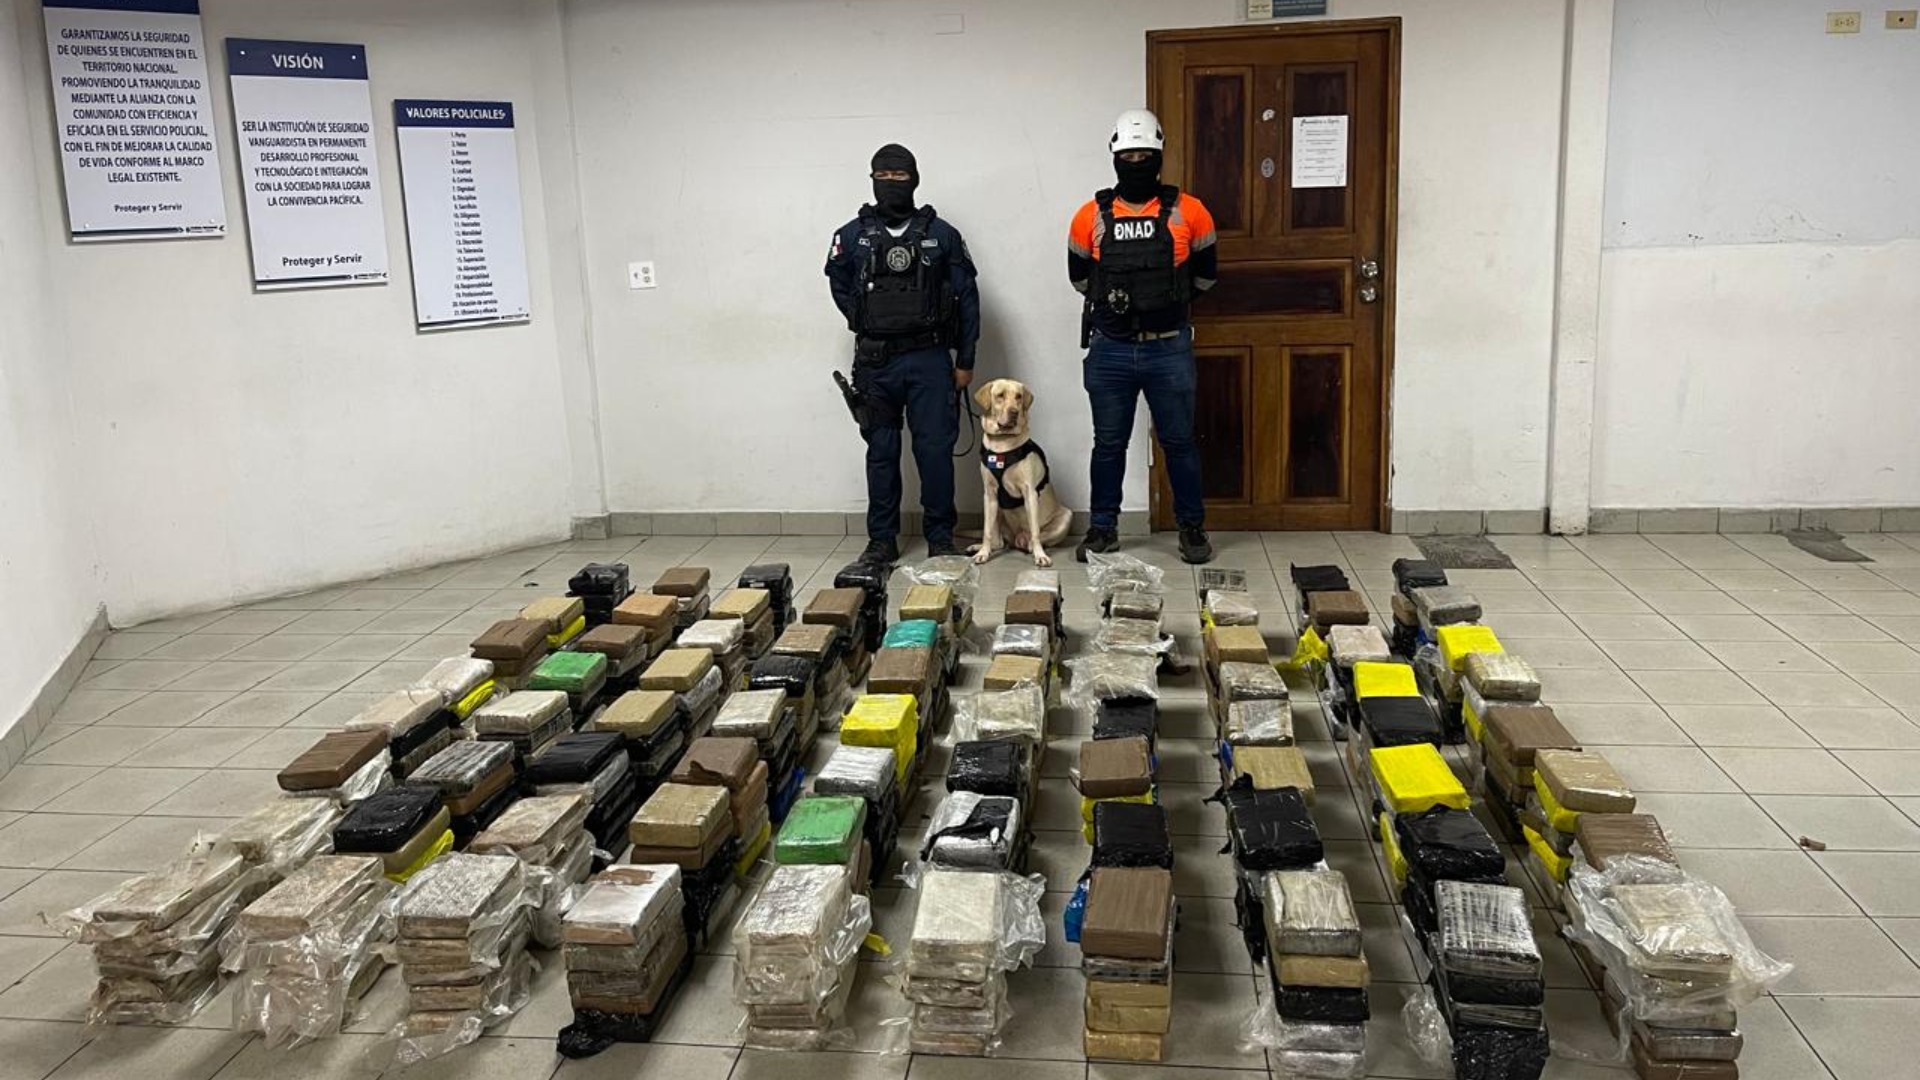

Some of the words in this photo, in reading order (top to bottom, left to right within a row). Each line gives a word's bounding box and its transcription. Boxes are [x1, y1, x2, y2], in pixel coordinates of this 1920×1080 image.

[61, 29, 129, 40] GARANTIZAMOS
[131, 31, 141, 41] LA
[143, 32, 190, 43] SEGURIDAD
[58, 45, 70, 54] DE
[71, 45, 107, 56] QUIENES
[110, 46, 119, 56] SE
[121, 47, 174, 58] ENCUENTREN
[176, 49, 186, 59] EN
[189, 50, 198, 59] EL
[272, 53, 324, 69] VISIÓN
[82, 62, 130, 72] TERRITORIO
[62, 77, 126, 88] PROMOVIENDO
[128, 78, 138, 88] LA
[140, 79, 201, 90] TRANQUILIDAD
[72, 93, 115, 103] MEDIANTE
[117, 94, 127, 103] LA
[130, 94, 165, 104] ALIANZA
[167, 95, 183, 104] CON
[186, 95, 196, 104] LA
[73, 109, 126, 119] COMUNIDAD
[129, 110, 146, 119] CON
[148, 110, 191, 120] EFICIENCIA
[406, 107, 450, 118] VALORES
[451, 108, 504, 119] POLICIALES
[67, 125, 105, 136] EFICACIA
[106, 125, 118, 136] EN
[120, 125, 130, 136] EL
[130, 125, 168, 136] SERVICIO
[242, 121, 256, 131] SER
[258, 121, 267, 131] LA
[268, 120, 316, 132] INSTITUCIÓN
[317, 122, 327, 132] DE
[328, 122, 370, 132] SEGURIDAD
[64, 142, 83, 152] CON
[85, 142, 95, 152] EL
[96, 142, 110, 152] FIN
[112, 142, 123, 151] DE
[124, 142, 164, 151] MEJORAR
[165, 142, 175, 151] LA
[177, 142, 212, 151] CALIDAD
[248, 138, 306, 147] VANGUARDISTA
[308, 138, 318, 147] EN
[320, 138, 366, 147] PERMANENTE
[260, 153, 309, 161] DESARROLLO
[311, 152, 359, 161] PROFESIONAL
[79, 158, 91, 167] DE
[92, 158, 113, 167] VIDA
[114, 157, 161, 167] CONFORME
[163, 157, 173, 167] AL
[175, 157, 205, 166] MARCO
[261, 166, 313, 176] TECNOLÓGICO
[321, 166, 368, 176] INTEGRACIÓN
[108, 173, 134, 182] LEGAL
[255, 182, 272, 191] CON
[273, 182, 282, 191] LA
[284, 182, 321, 191] SOCIEDAD
[322, 181, 340, 190] PARA
[342, 181, 371, 190] LOGRAR
[268, 197, 277, 206] LA
[279, 196, 329, 206] CONVIVENCIA
[114, 204, 150, 213] Proteger
[158, 203, 182, 211] Servir
[282, 257, 324, 267] Proteger
[327, 257, 332, 266] y
[334, 253, 362, 263] Servir
